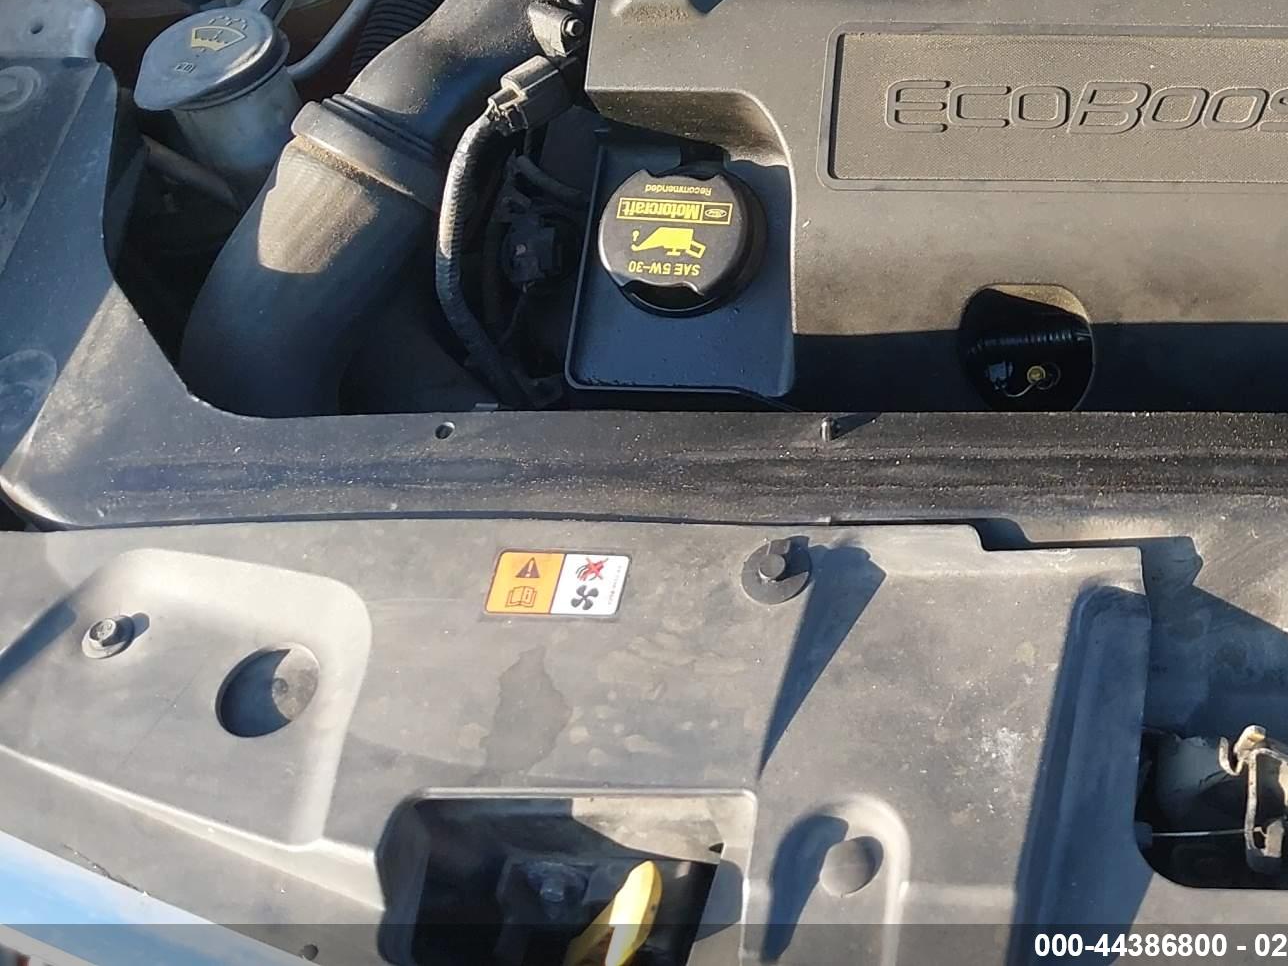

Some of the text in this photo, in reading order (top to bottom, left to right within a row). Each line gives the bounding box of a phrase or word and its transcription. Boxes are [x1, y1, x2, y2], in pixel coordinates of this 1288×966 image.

[645, 184, 712, 196] Recommended
[622, 200, 701, 220] Motorcraft
[628, 260, 701, 276] SAE 5W-30
